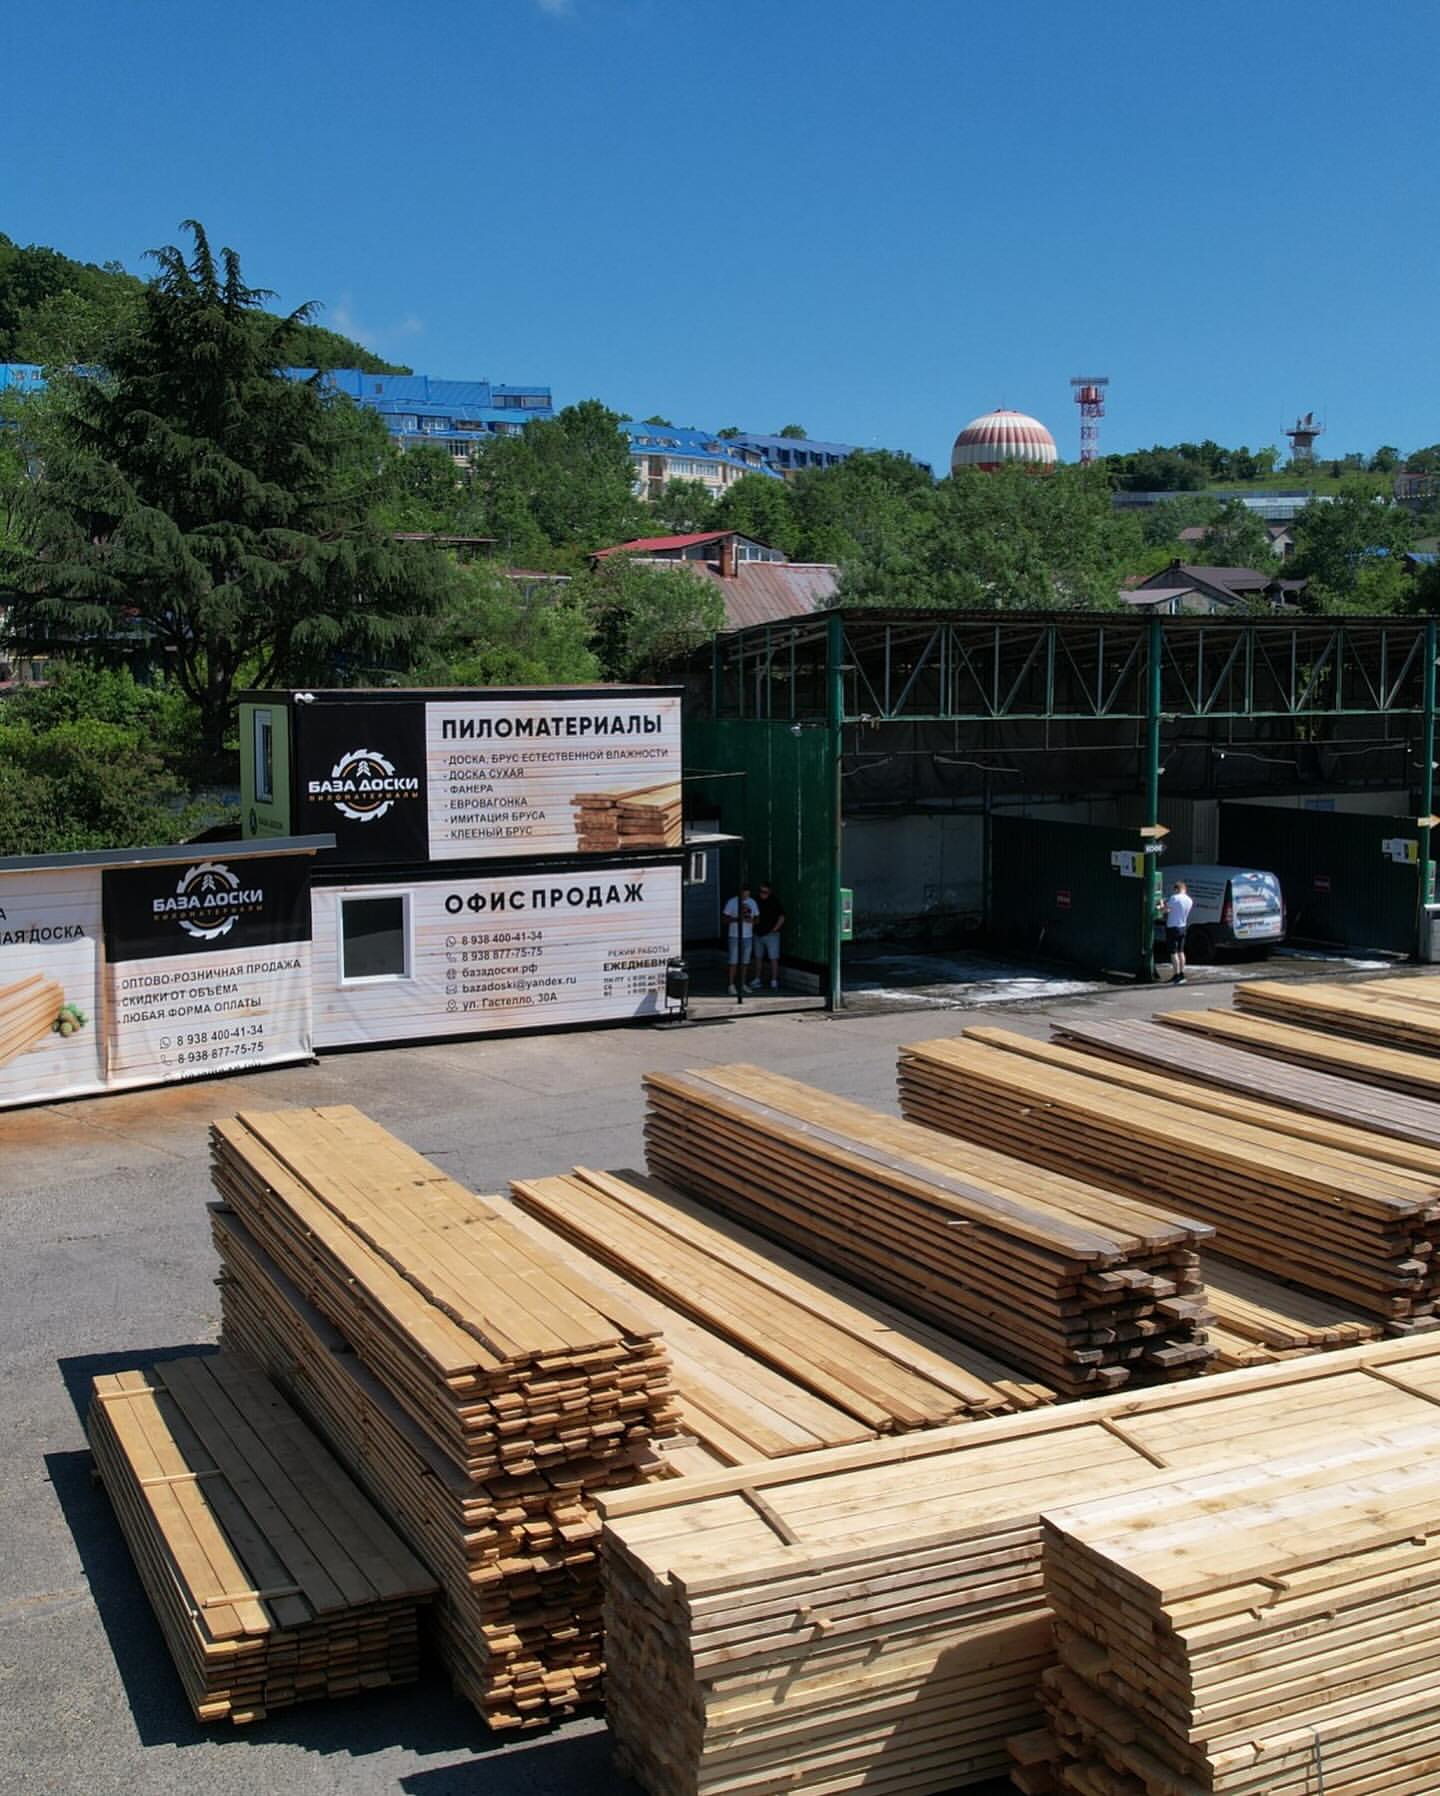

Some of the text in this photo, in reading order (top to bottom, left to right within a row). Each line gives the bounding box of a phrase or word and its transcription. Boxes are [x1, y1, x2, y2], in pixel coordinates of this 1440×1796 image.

[442, 714, 661, 739] ПИЛОМАТЕРИАЛЫ
[491, 753, 519, 764] БРУС
[522, 750, 604, 762] ЕСТЕСТВЕННОЙ
[606, 748, 669, 760] ВЛАЖНОСТИ
[448, 768, 524, 781] ДОСКА СУХАЯ
[308, 777, 419, 793] БАЗА ДОСКИ
[449, 784, 494, 795] ФАНЕРА
[449, 796, 528, 809] ЕВРОВАГОНКА
[450, 811, 546, 824] ИМИТАЦИЯ БРУСА
[450, 825, 533, 839] КЛЕЕНЫЙ БРУС
[153, 889, 263, 912] БАЗА ДОСКИ
[444, 882, 645, 915] ОФИС ПРОДАЖ
[29, 925, 85, 944] ДОСКА
[462, 930, 543, 946] 8 938 400-41-34
[462, 946, 543, 962] 8 938 877-75-75
[603, 958, 668, 972] ЕЖЕДНЕВН
[121, 959, 302, 990] ОПТОВО-РОЗНИЧНАЯ ПРОДАЖА
[121, 984, 239, 1007] СКИДКИ ОТ ОБЪЕМА
[122, 997, 262, 1024] ЛЮБАЯ ФОРМА ОПЛАТЫ
[176, 1024, 264, 1046] 8 938 400-41-34
[177, 1041, 264, 1064] 8 938 877-75-75
